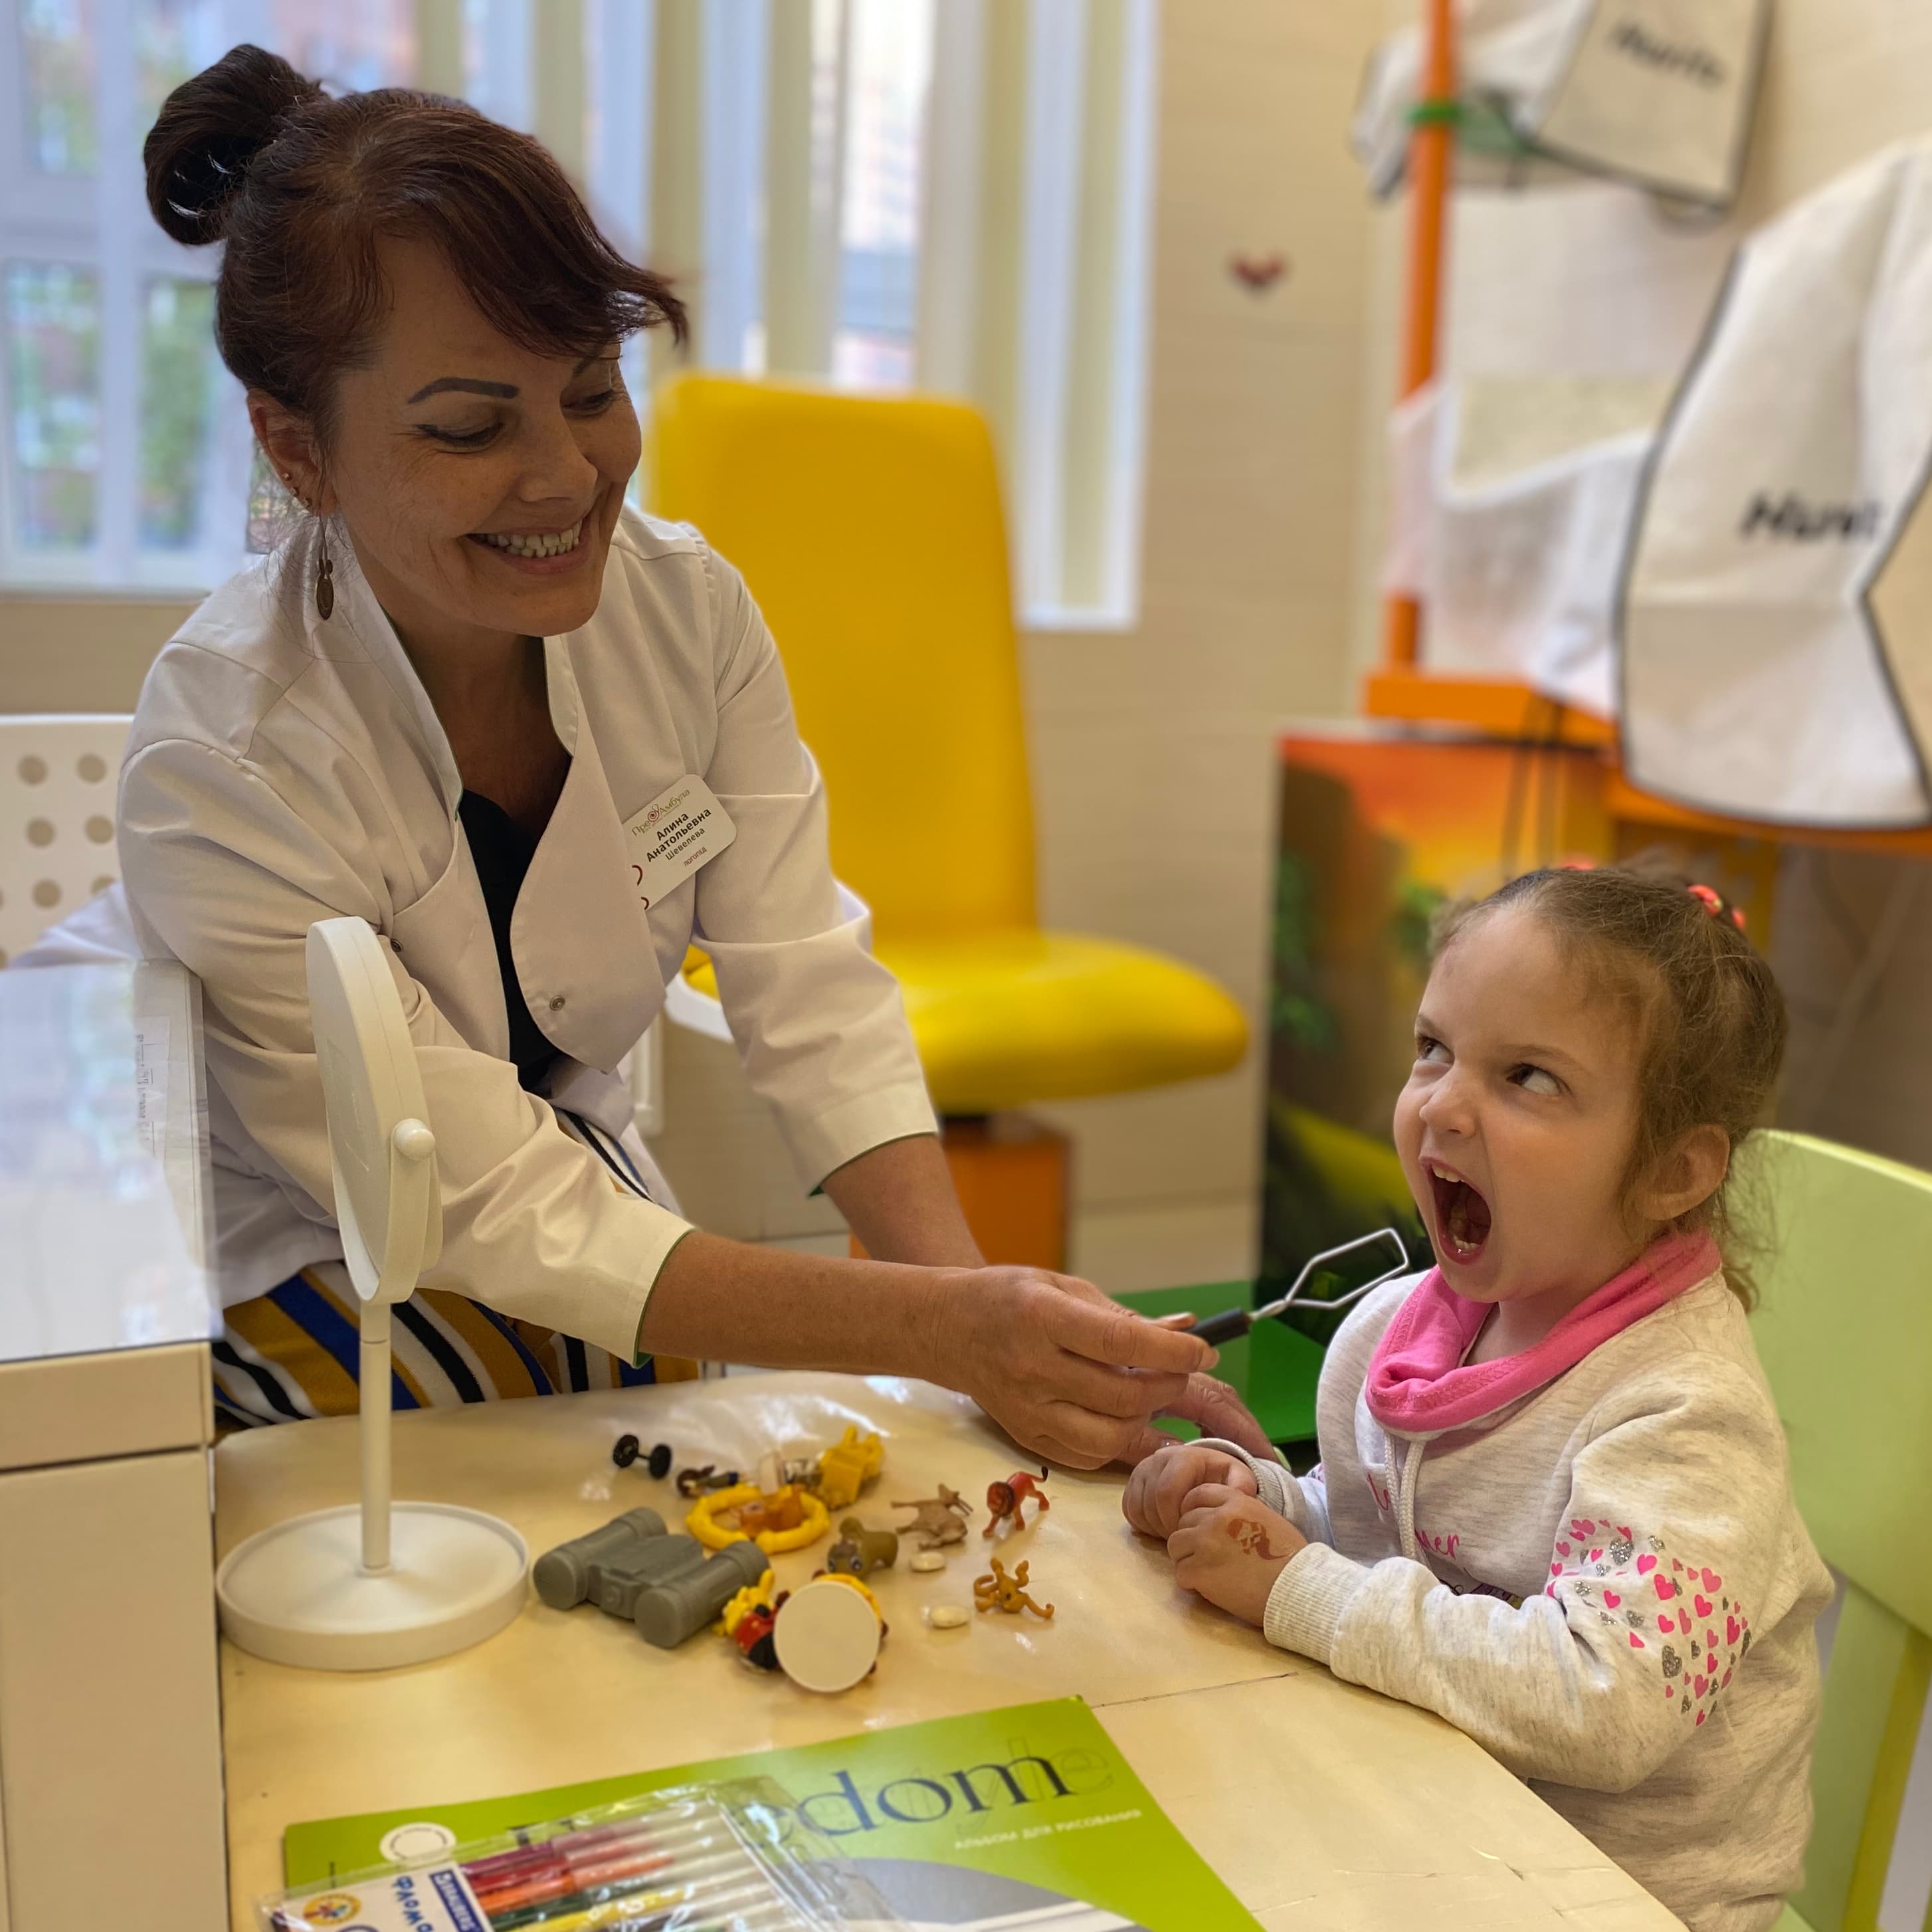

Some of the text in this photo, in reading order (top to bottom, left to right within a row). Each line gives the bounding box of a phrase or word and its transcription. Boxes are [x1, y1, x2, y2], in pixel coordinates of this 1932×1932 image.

[646, 809, 712, 862] Анатольевна
[656, 813, 689, 840] Алина
[665, 828, 705, 860] Шевелева
